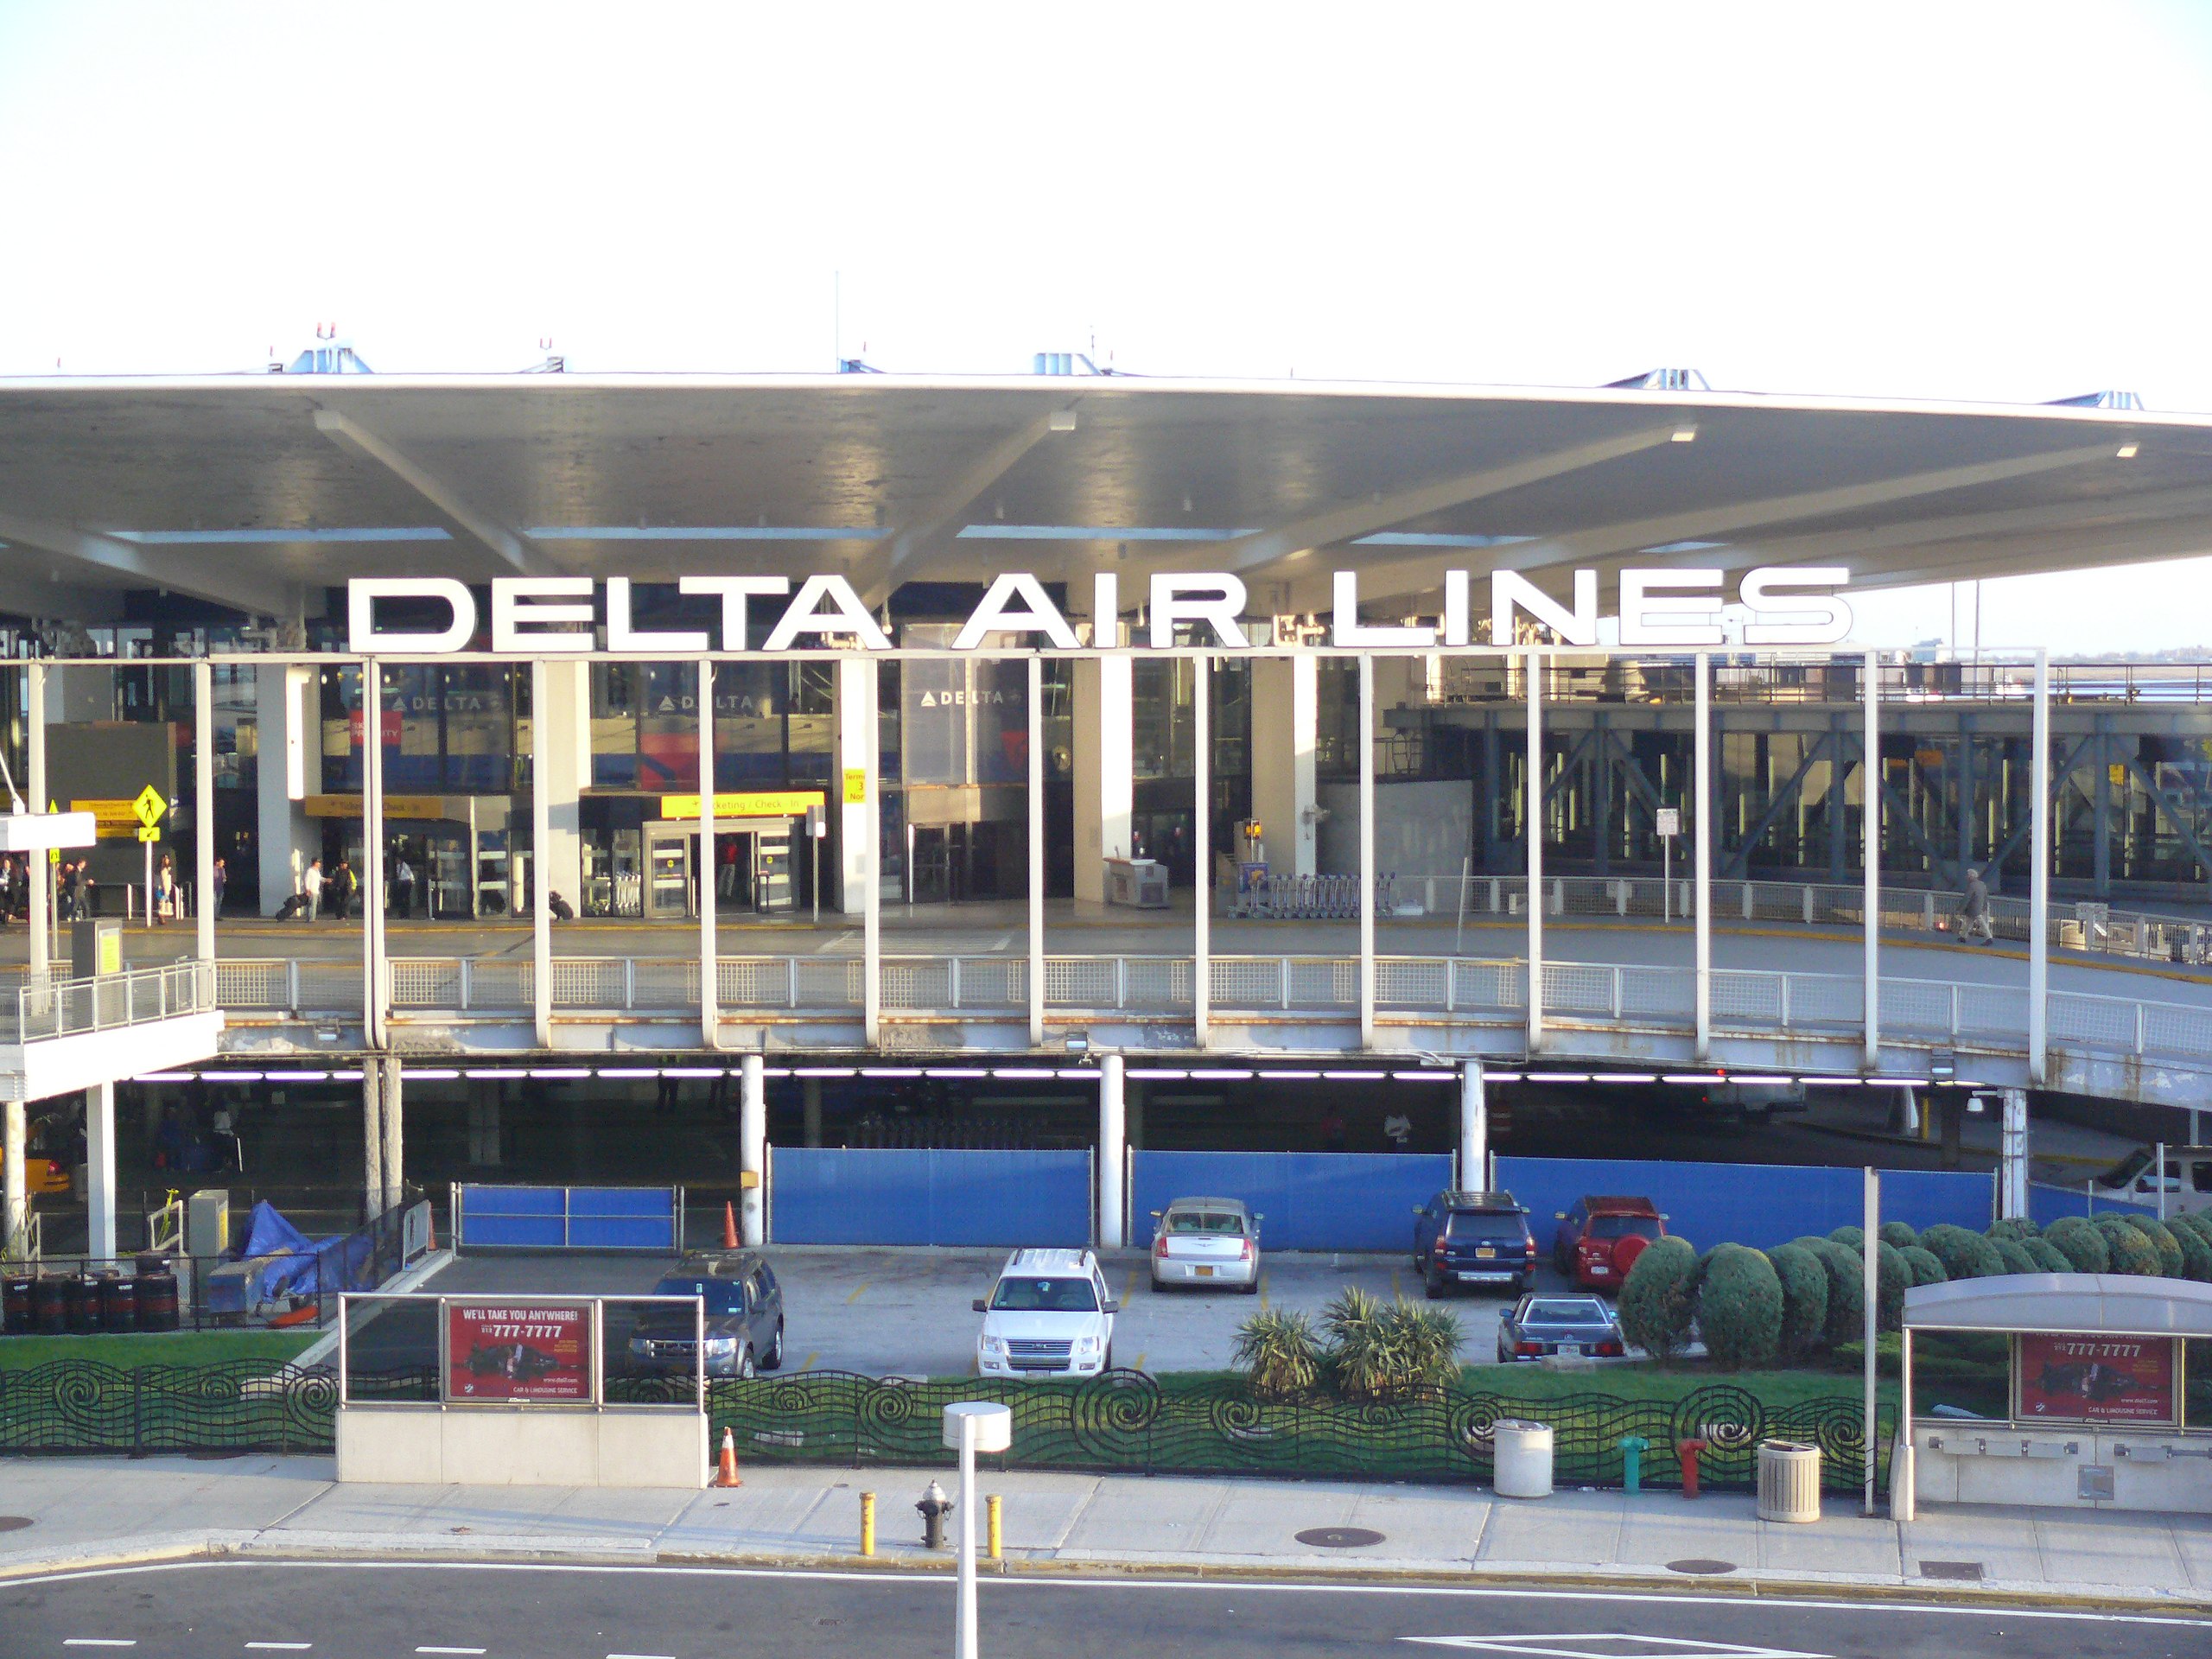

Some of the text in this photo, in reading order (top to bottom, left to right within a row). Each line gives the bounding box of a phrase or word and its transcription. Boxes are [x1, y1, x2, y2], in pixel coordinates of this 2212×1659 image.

[348, 567, 1853, 652] DELTA AIR LINES
[412, 696, 481, 710] DELTA
[681, 695, 753, 709] DLTA
[940, 691, 1003, 705] DELTA
[858, 782, 864, 791] 3
[712, 799, 746, 810] cketing
[754, 799, 782, 809] Check
[463, 1309, 578, 1321] WE'LL TAKE YOU ANYWHERE!
[493, 1325, 563, 1338] 777-7777
[2067, 1343, 2141, 1357] 777-7777
